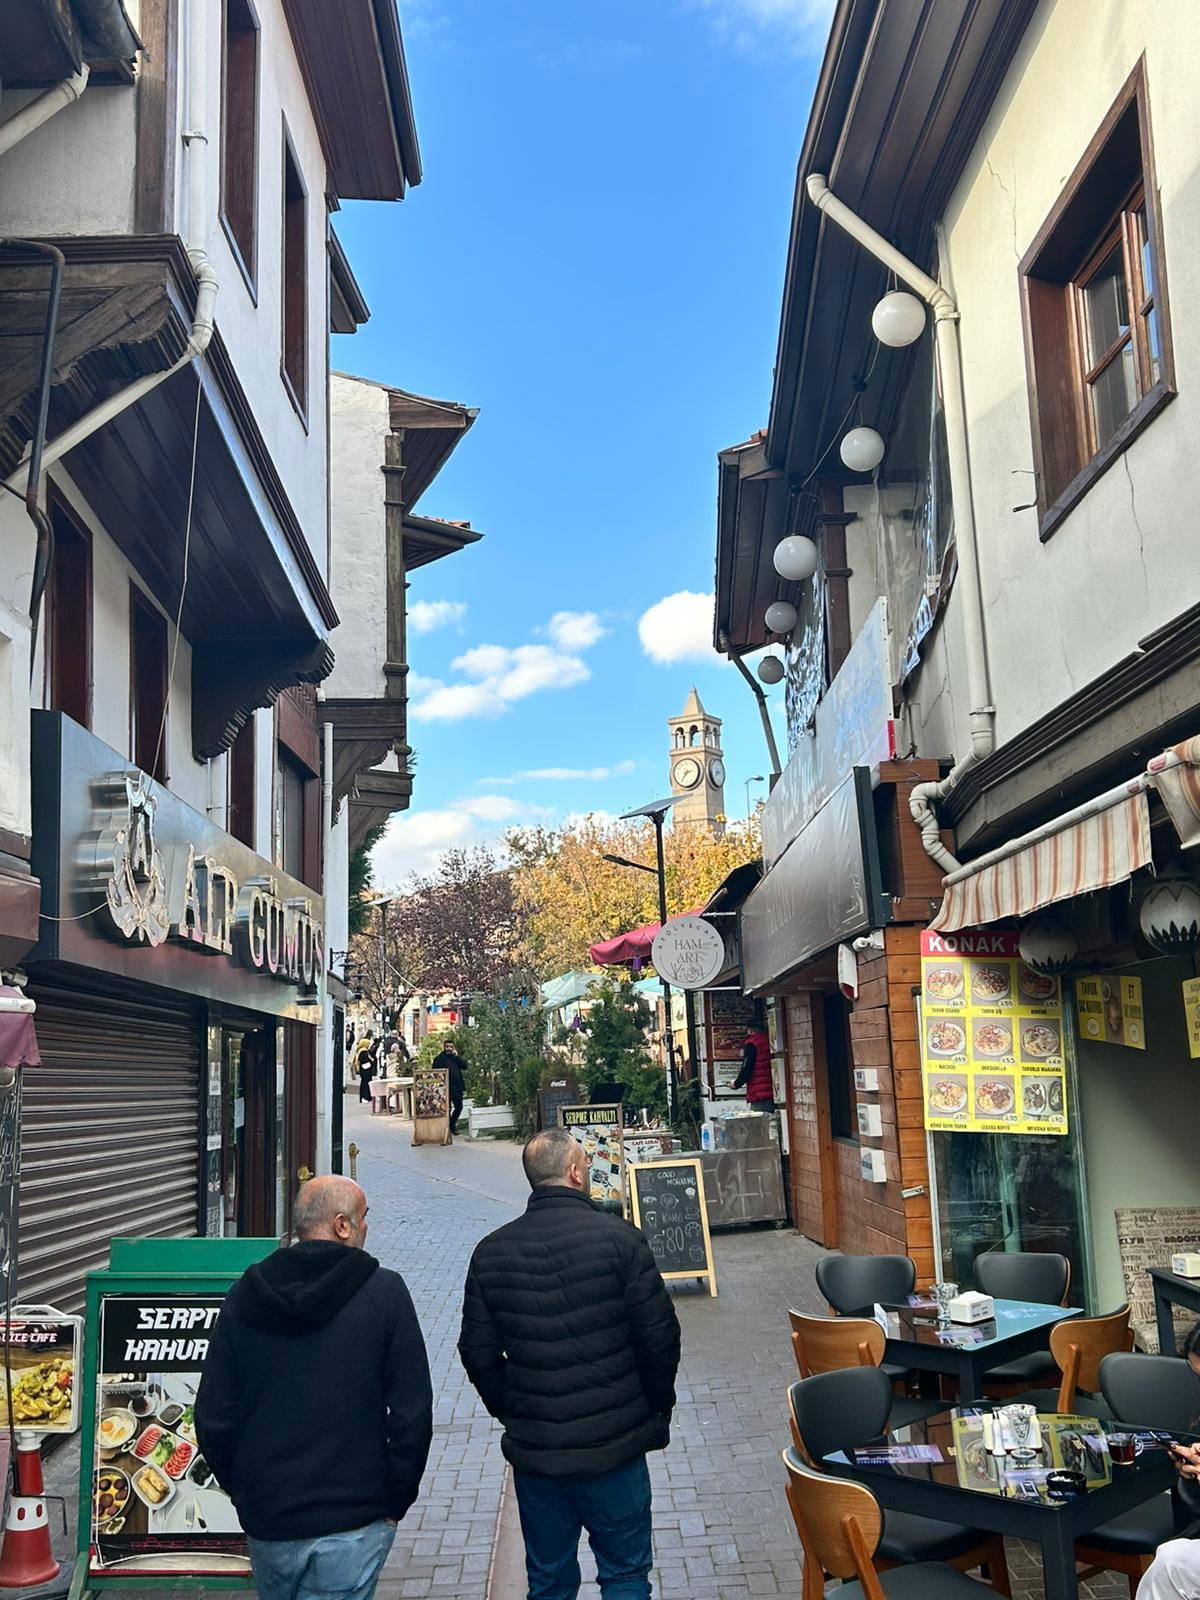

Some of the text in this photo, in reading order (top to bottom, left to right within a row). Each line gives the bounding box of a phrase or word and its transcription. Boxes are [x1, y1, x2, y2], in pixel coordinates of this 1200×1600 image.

[674, 938, 702, 950] HAM
[928, 935, 1006, 953] KONAK
[565, 1110, 616, 1124] SERPME KAHVALTI
[657, 1171, 676, 1179] GOOD
[666, 1177, 697, 1186] MORNING
[666, 1226, 685, 1253] 80
[30, 1333, 57, 1343] CAFE
